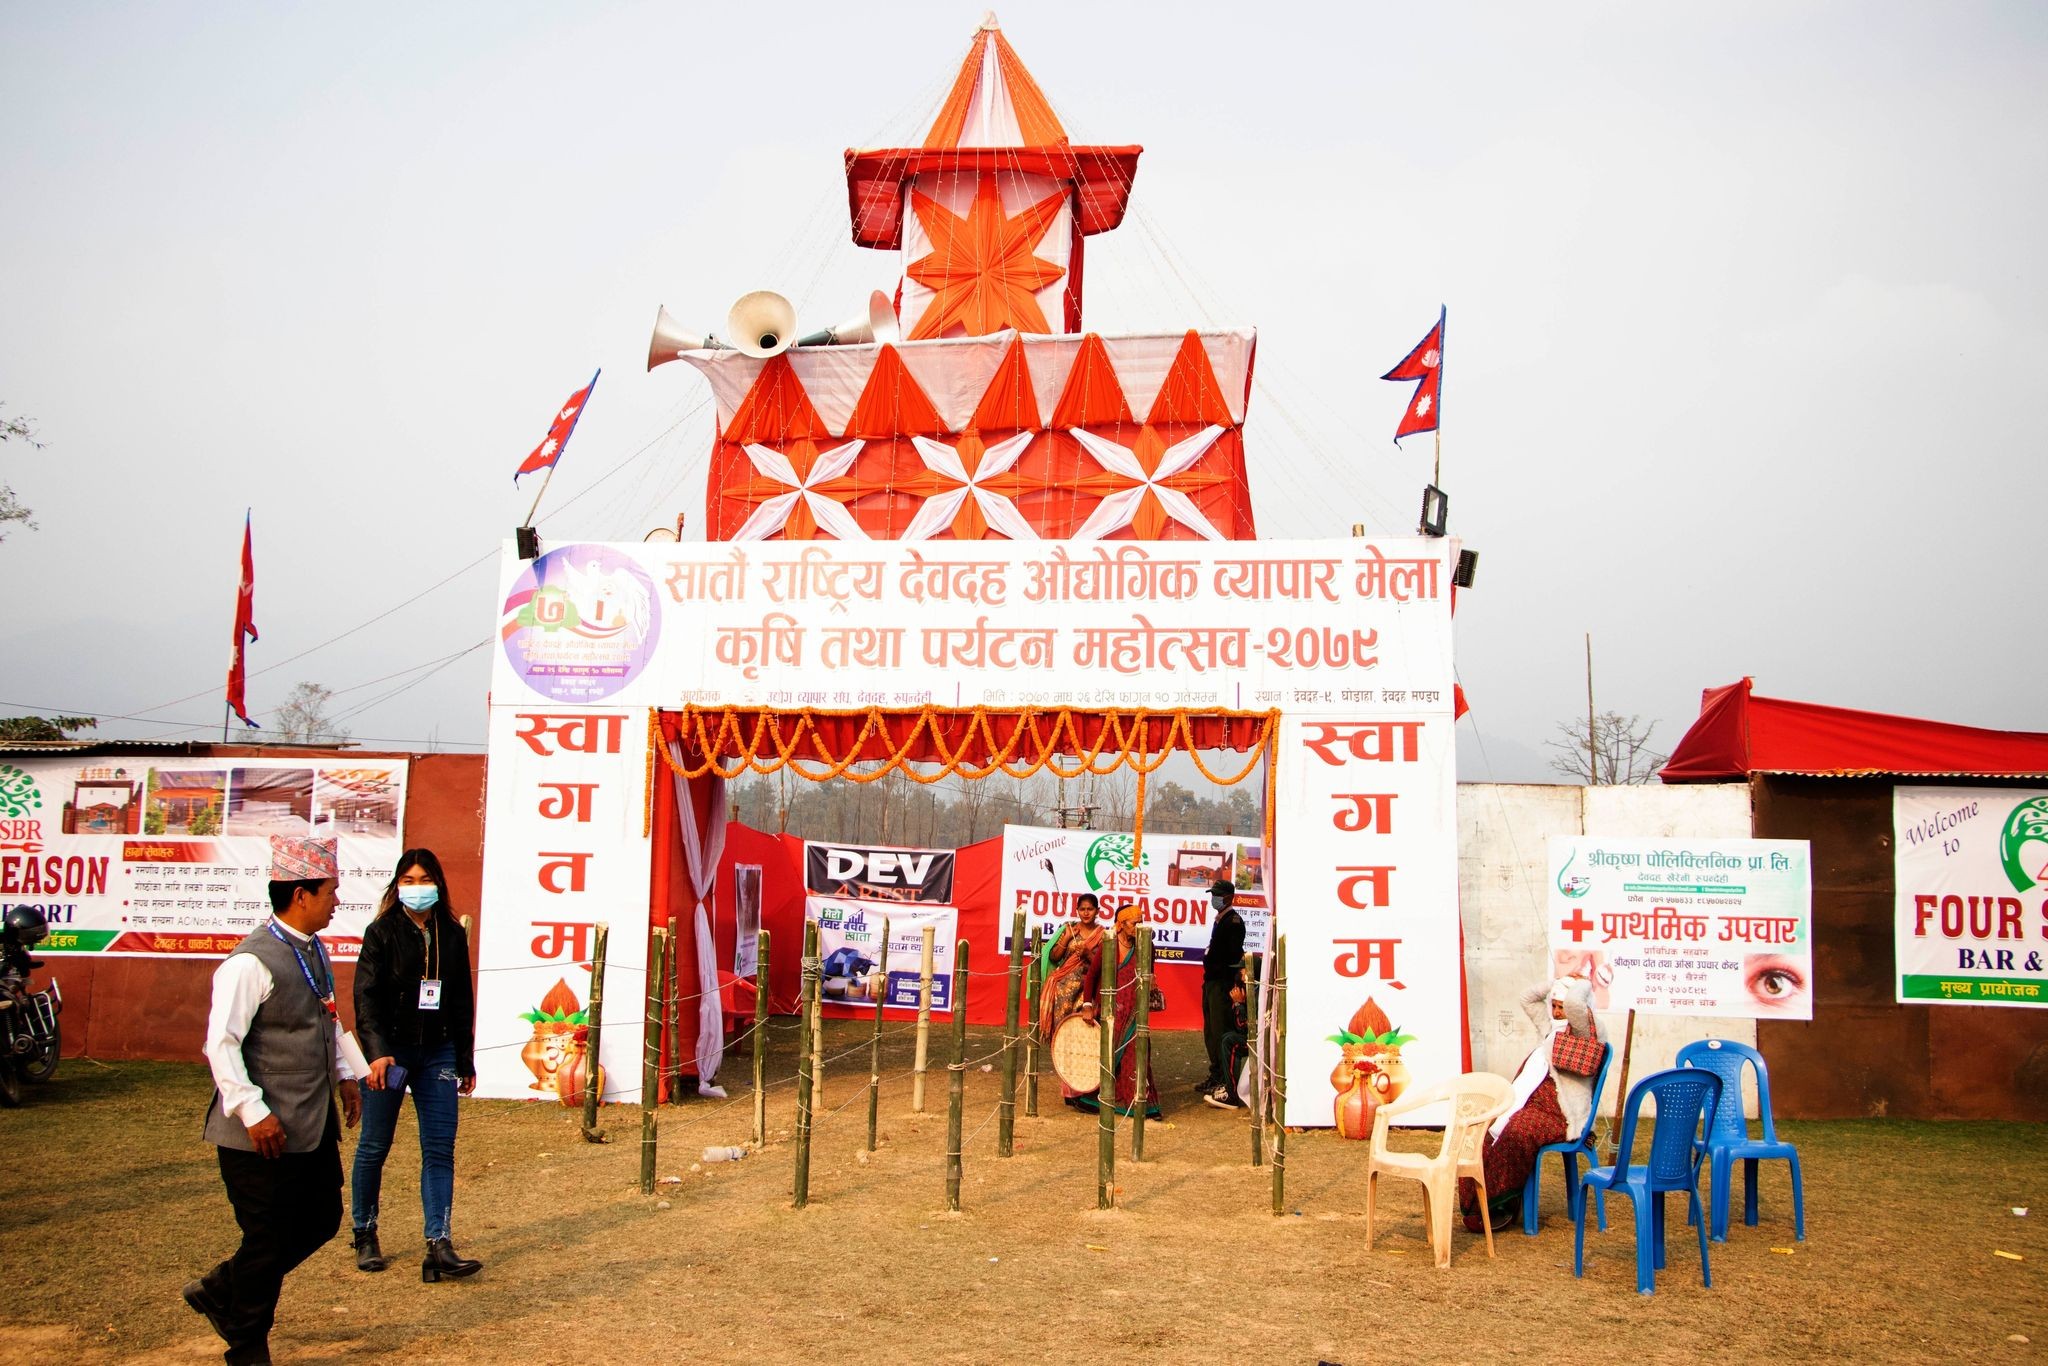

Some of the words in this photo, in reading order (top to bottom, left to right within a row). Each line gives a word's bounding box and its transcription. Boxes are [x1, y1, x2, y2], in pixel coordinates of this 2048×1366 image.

[665, 546, 749, 603] सातौ
[762, 546, 886, 613] राष्ट्रिय
[900, 548, 1010, 605] देवदह
[1023, 545, 1200, 601] औद्योगिक
[1214, 559, 1342, 601] व्यापार
[1355, 545, 1440, 601] मेला
[716, 612, 806, 679] कृषि
[821, 628, 905, 670] तथा
[921, 616, 1058, 668] पर्यटन
[798, 691, 827, 703] व्यापार
[1382, 688, 1406, 703] देवदह
[1906, 801, 1979, 847] Welcome
[1014, 834, 1066, 863] Welcome
[1943, 838, 1960, 856] to
[826, 850, 935, 885] DEV
[1588, 848, 1641, 871] श्रीकृष्ण
[1647, 849, 1742, 871] पोलिक्लिनिक
[1104, 871, 1117, 891] 4
[1118, 871, 1149, 886] SBR
[1601, 906, 1709, 944] प्राथमिक
[1718, 915, 1799, 944] उपचार
[1914, 895, 2024, 939] FOUR
[1658, 959, 1672, 969] तथा
[1958, 948, 2016, 971] BAR
[2024, 950, 2043, 971] &
[1940, 981, 1973, 998] मुख्य
[1979, 980, 2040, 997] प्रायोजक
